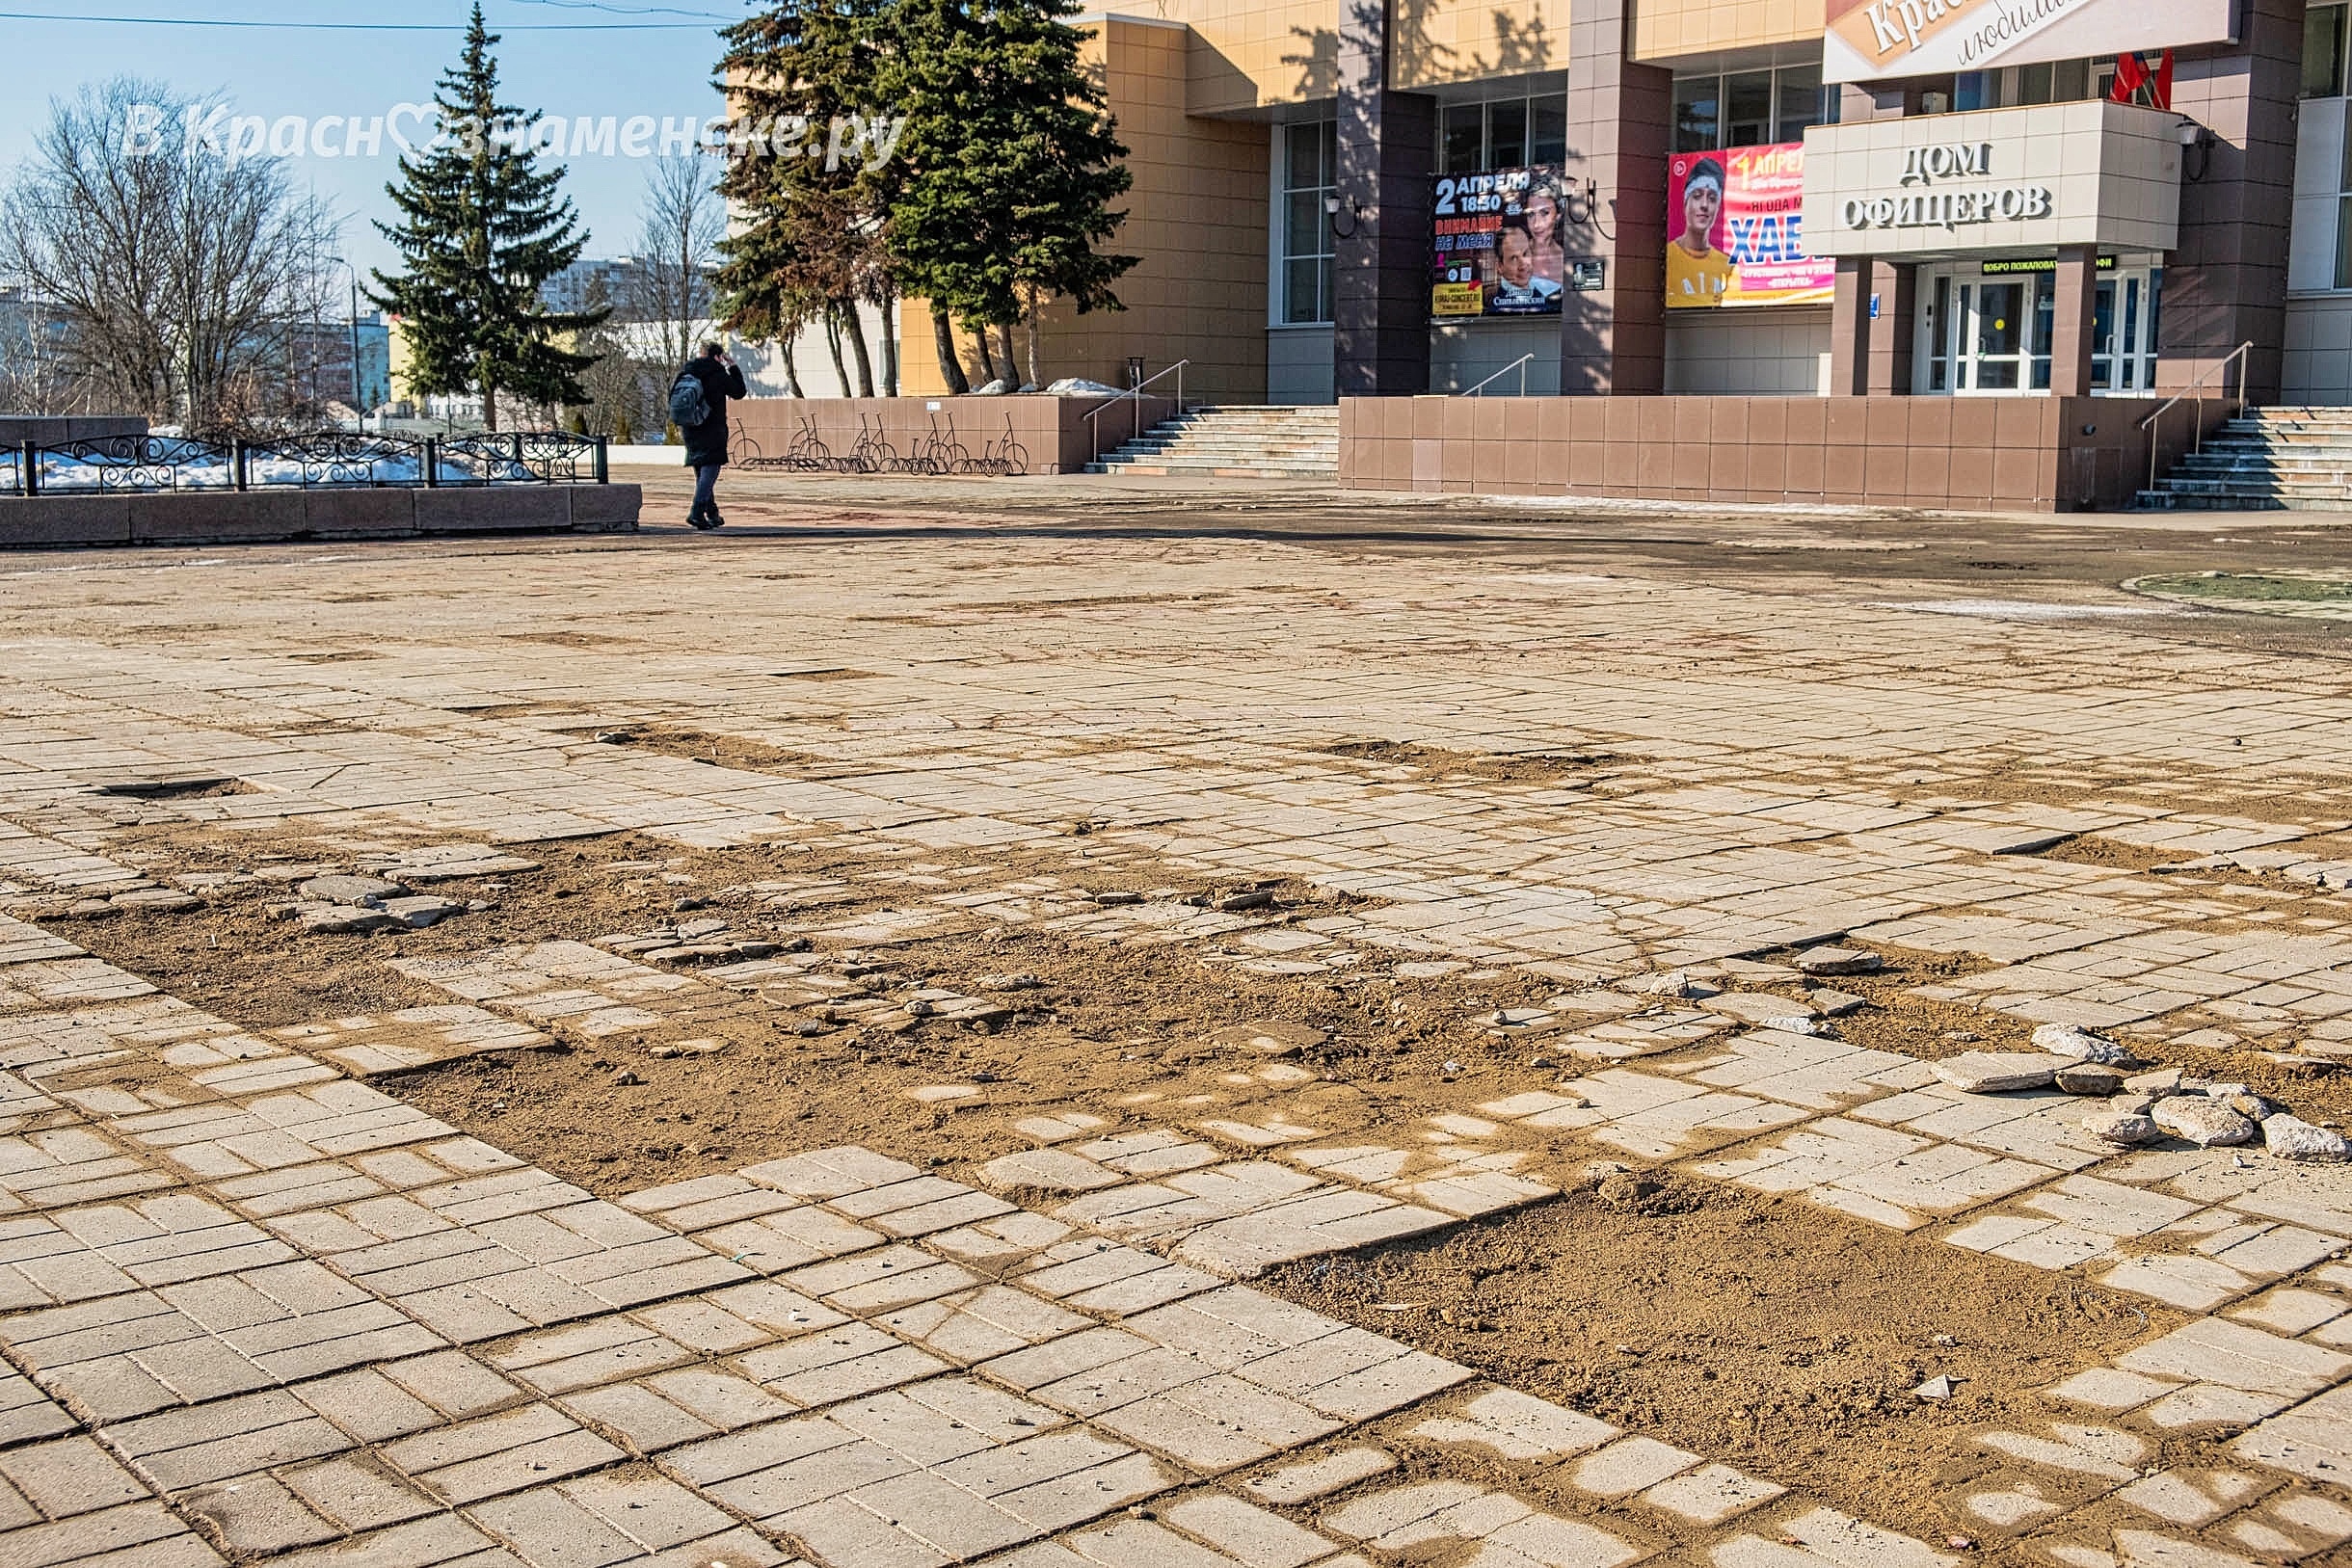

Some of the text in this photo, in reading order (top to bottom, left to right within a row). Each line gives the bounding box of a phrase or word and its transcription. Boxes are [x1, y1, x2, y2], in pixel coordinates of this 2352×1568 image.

[1736, 155, 1750, 190] 1
[1899, 143, 1992, 187] ДОМ
[1435, 172, 1531, 214] 2 АПРЕЛЯ
[1842, 184, 2052, 232] ОФИЦЕРОВ
[1727, 214, 1810, 264] ХАБ
[2011, 259, 2057, 271] ПОЖАЛОВАТ
